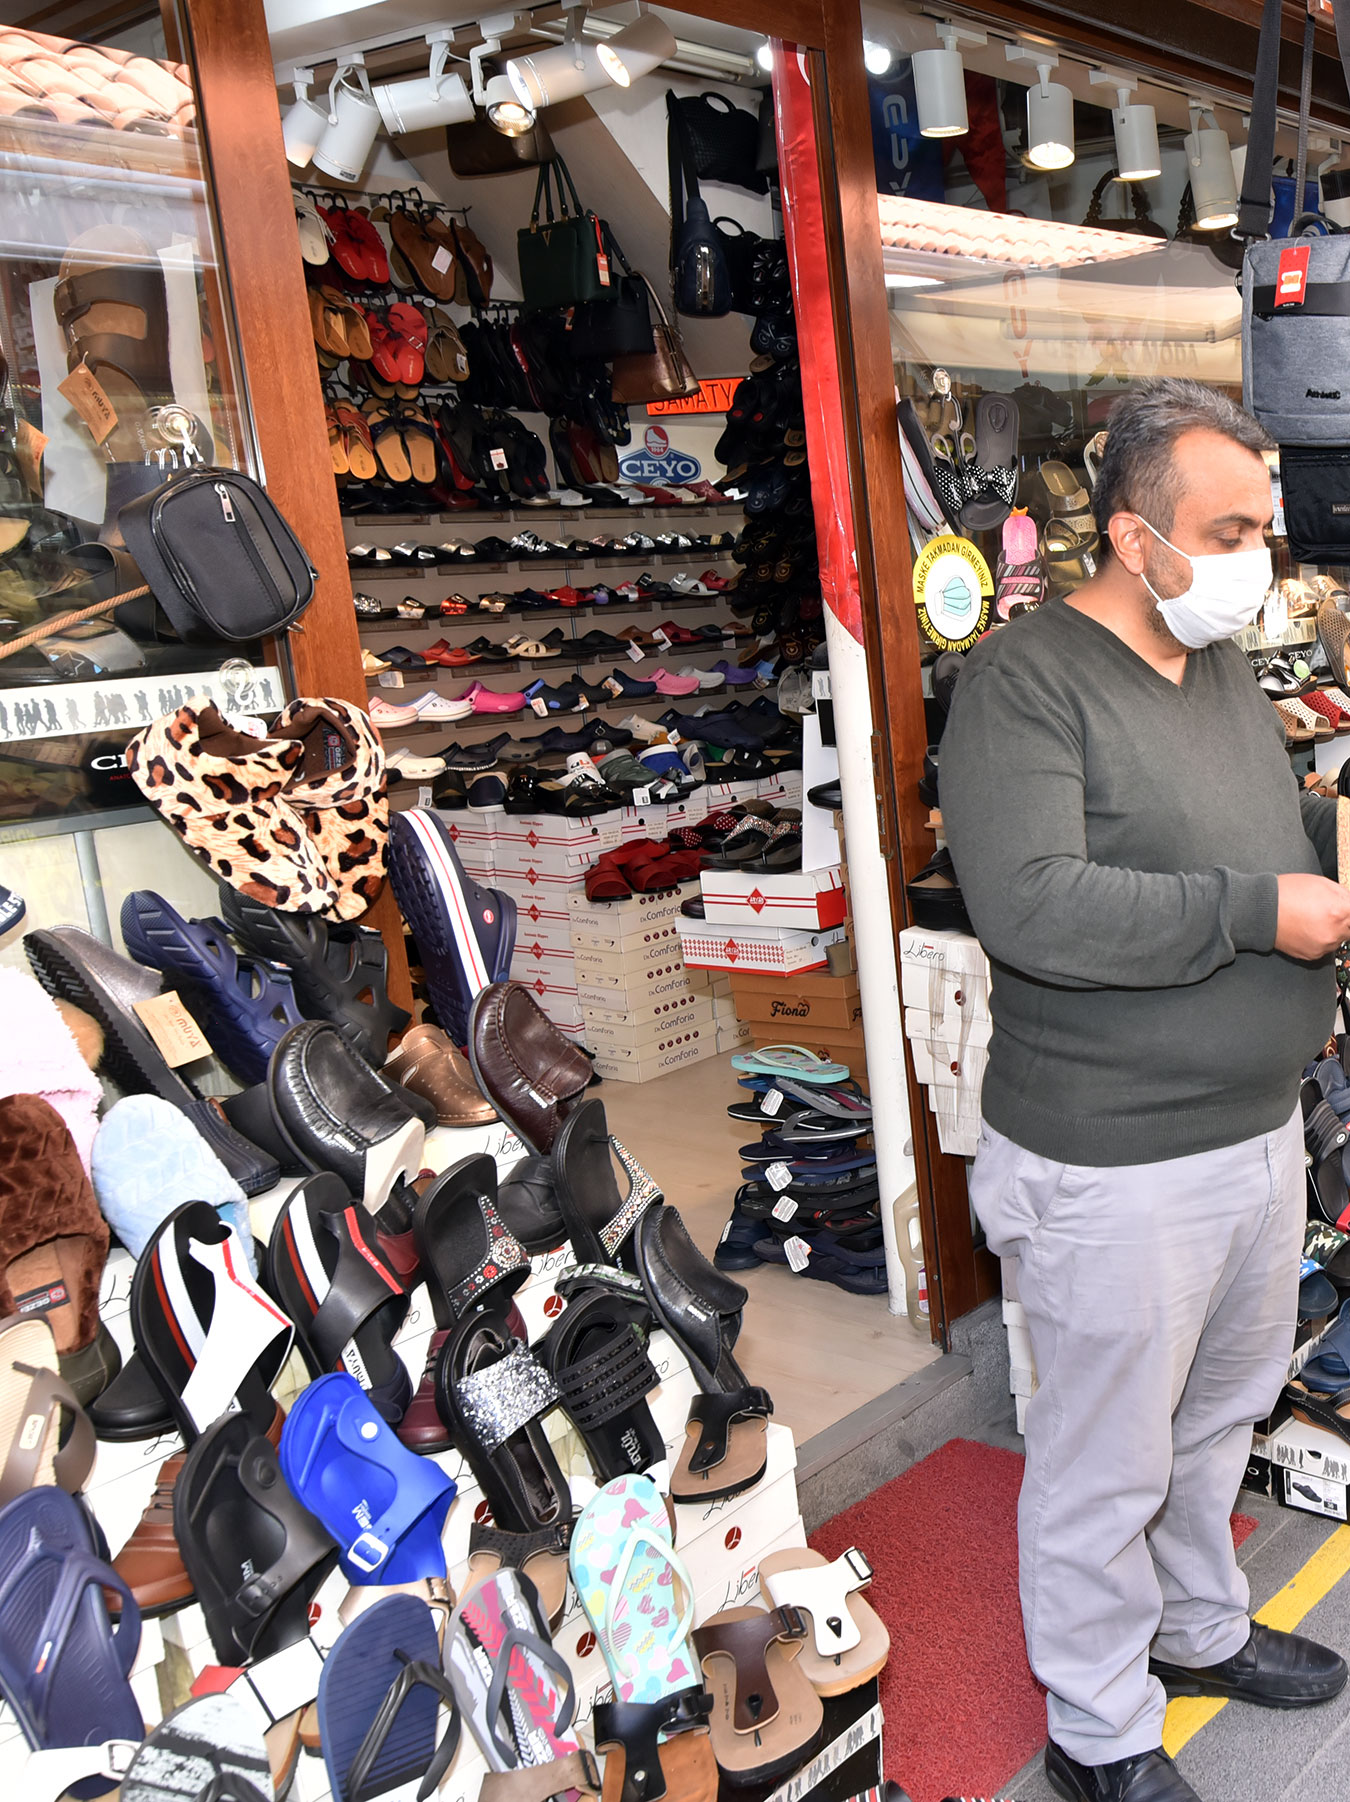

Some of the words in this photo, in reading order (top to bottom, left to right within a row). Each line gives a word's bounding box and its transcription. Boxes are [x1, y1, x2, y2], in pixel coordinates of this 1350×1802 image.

[622, 460, 696, 477] CEYO
[917, 562, 930, 593] MASKE
[926, 542, 960, 562] TAKMADAN
[960, 544, 988, 588] GİRMEYİNİZ
[976, 600, 990, 632] MASKE
[917, 606, 948, 649] GİRMEYİNİZ
[947, 630, 981, 652] TAKMADAN
[1251, 656, 1271, 668] CEY
[334, 747, 342, 768] GEZE
[643, 942, 683, 962] Dr.Comfori
[903, 939, 945, 962] Libero
[770, 1000, 810, 1018] Fiona
[20, 1296, 51, 1314] GEZE
[717, 1566, 760, 1613] Liber
